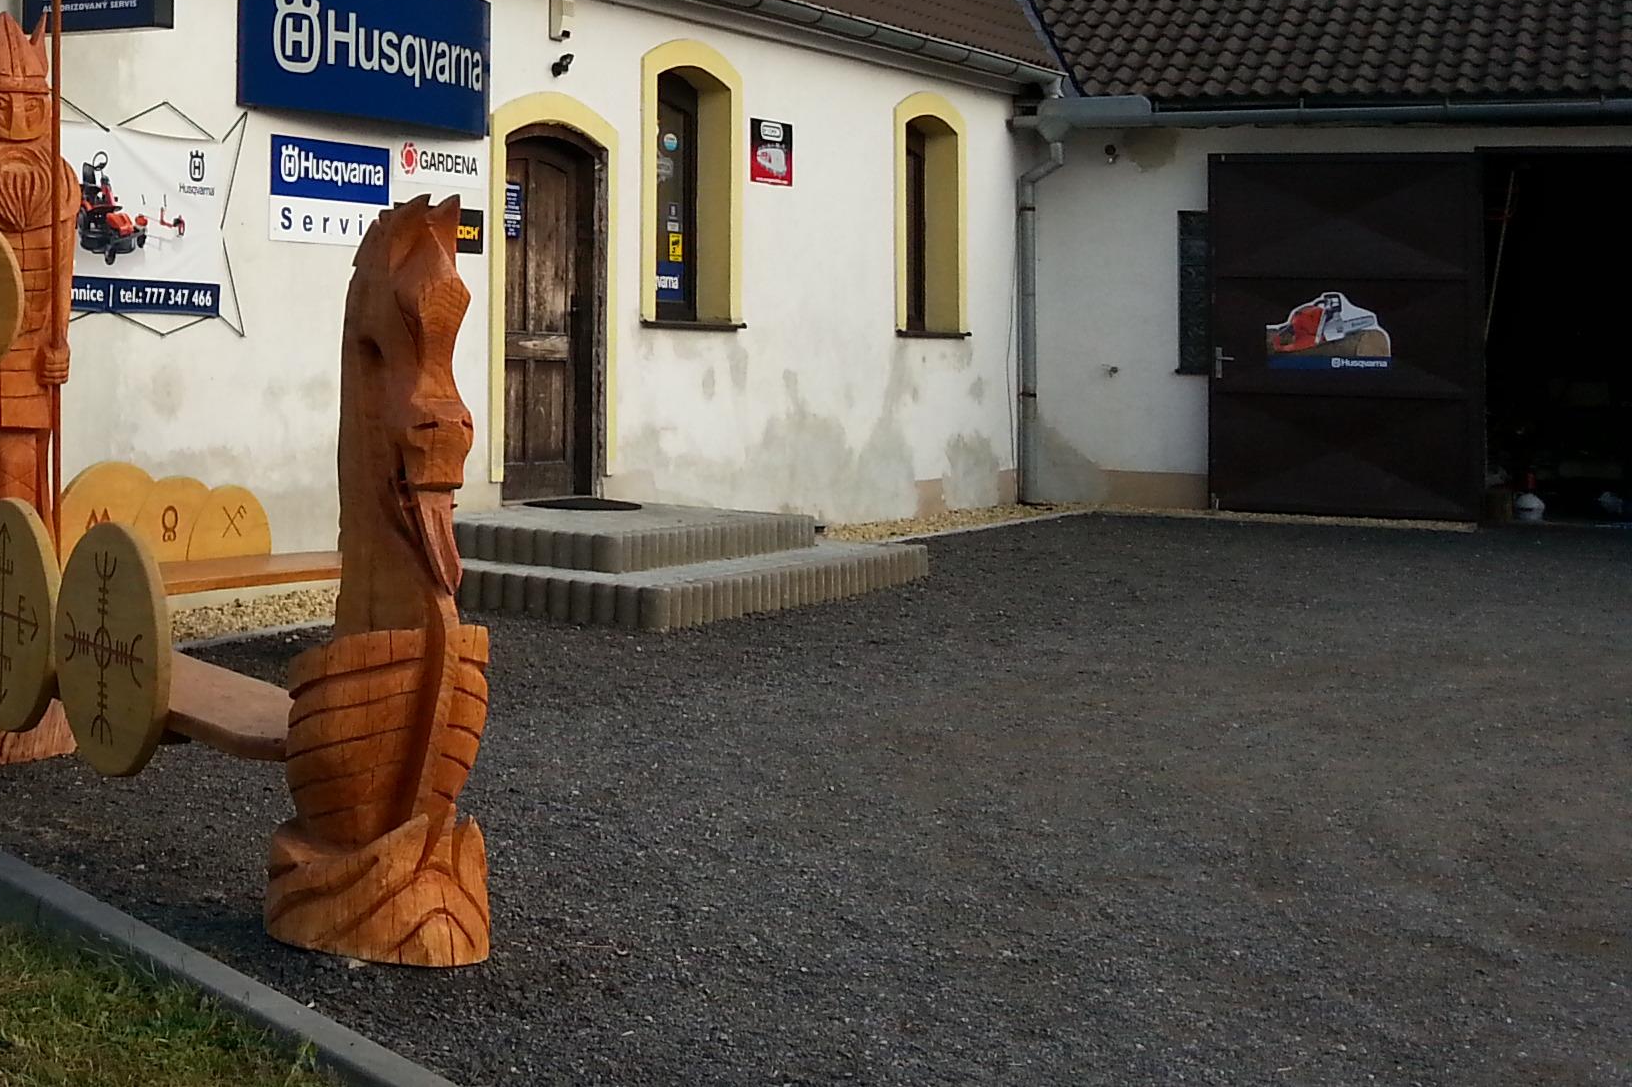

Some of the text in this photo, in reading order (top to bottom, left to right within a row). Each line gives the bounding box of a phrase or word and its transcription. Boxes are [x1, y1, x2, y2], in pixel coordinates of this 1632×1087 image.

[42, 0, 137, 13] AUORIZOVANÝ SERVIS
[327, 9, 483, 92] Husqvarna
[300, 151, 384, 187] Husqvarna
[419, 150, 479, 176] GARDENA
[179, 183, 215, 197] Husqvarna
[280, 207, 363, 236] Servi
[457, 225, 479, 241] OCH
[655, 275, 679, 291] varna
[120, 286, 142, 304] tel.:
[144, 287, 166, 304] 777
[168, 289, 189, 305] 347
[192, 290, 212, 307] 466
